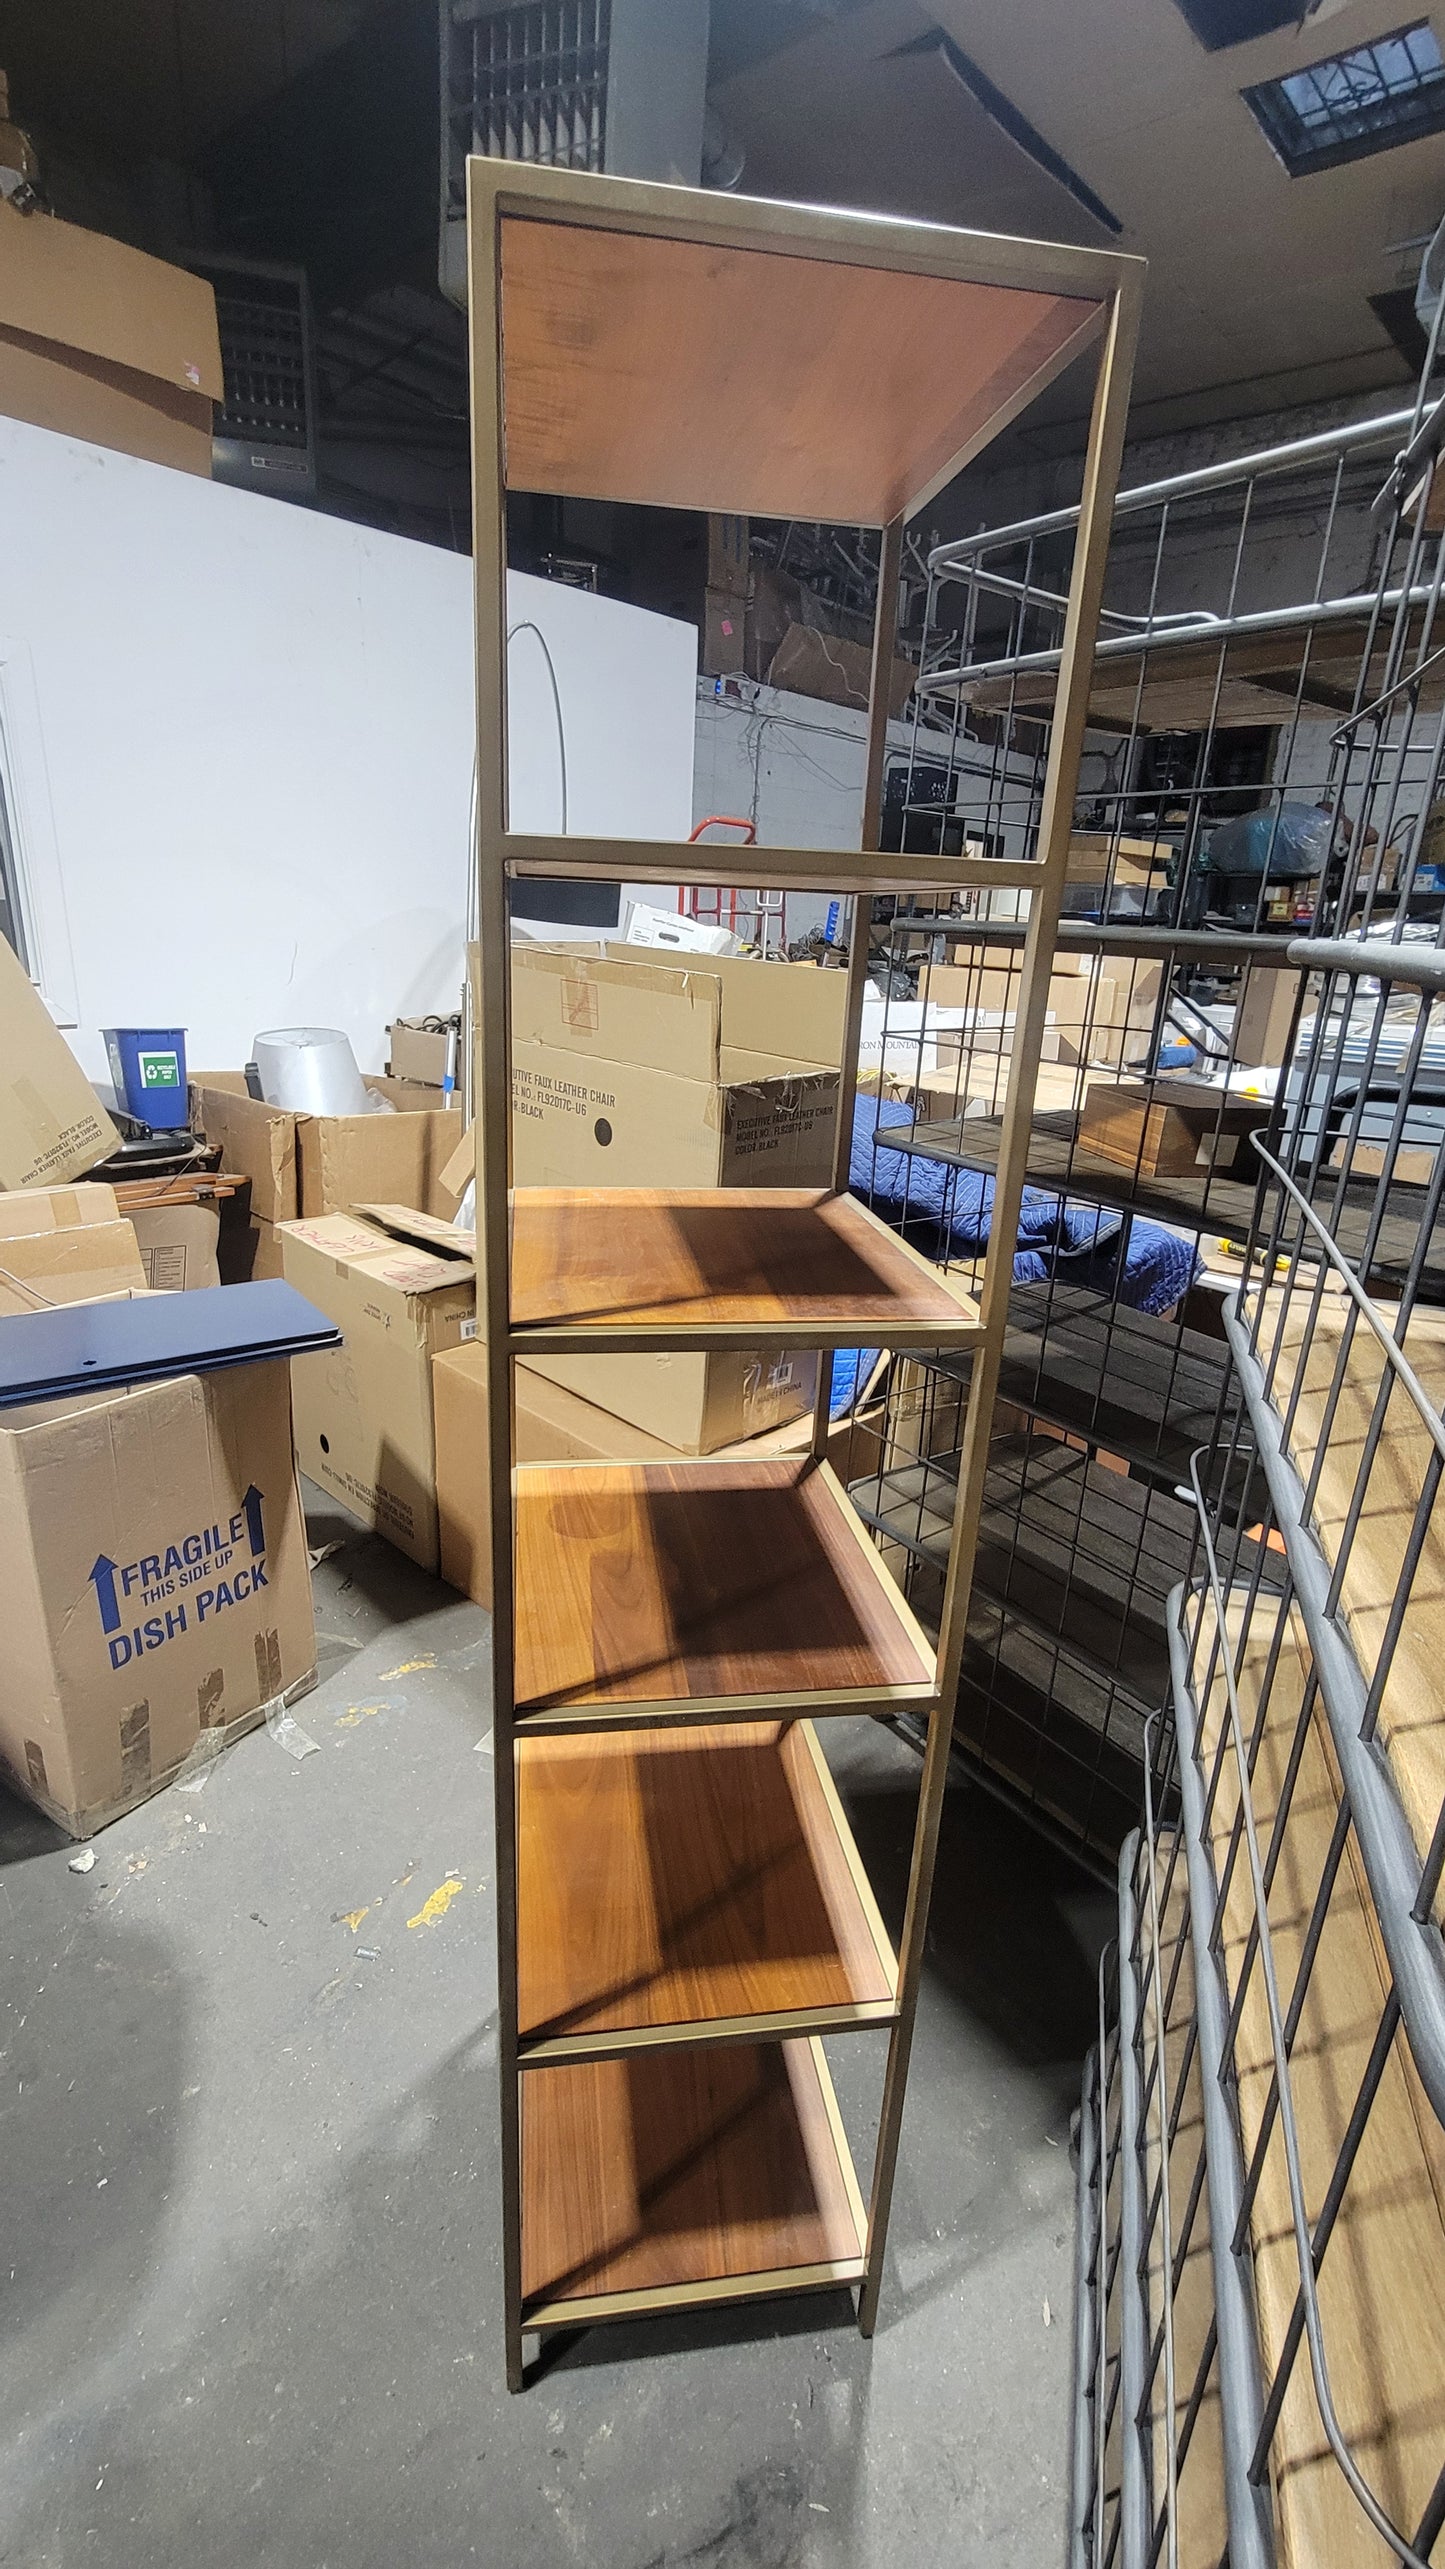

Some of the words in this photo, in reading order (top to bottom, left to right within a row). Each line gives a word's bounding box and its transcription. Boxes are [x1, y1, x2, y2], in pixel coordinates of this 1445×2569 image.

[877, 1040, 921, 1050] MOUNTAI
[534, 1074, 553, 1090] FAUX
[554, 1080, 588, 1100] LEATHER
[590, 1089, 616, 1108] CHAIR
[537, 1091, 588, 1116] FL92017C-U6
[737, 1116, 771, 1130] EXECUTIVE
[815, 1105, 835, 1118] CHAIR
[444, 1311, 466, 1323] CHINA
[121, 1512, 245, 1597] FRAGILE
[140, 1581, 175, 1607] THIS
[179, 1563, 212, 1588] SIDE
[215, 1550, 234, 1571] UP
[108, 1604, 188, 1671] DISH
[195, 1559, 270, 1624] PACK
